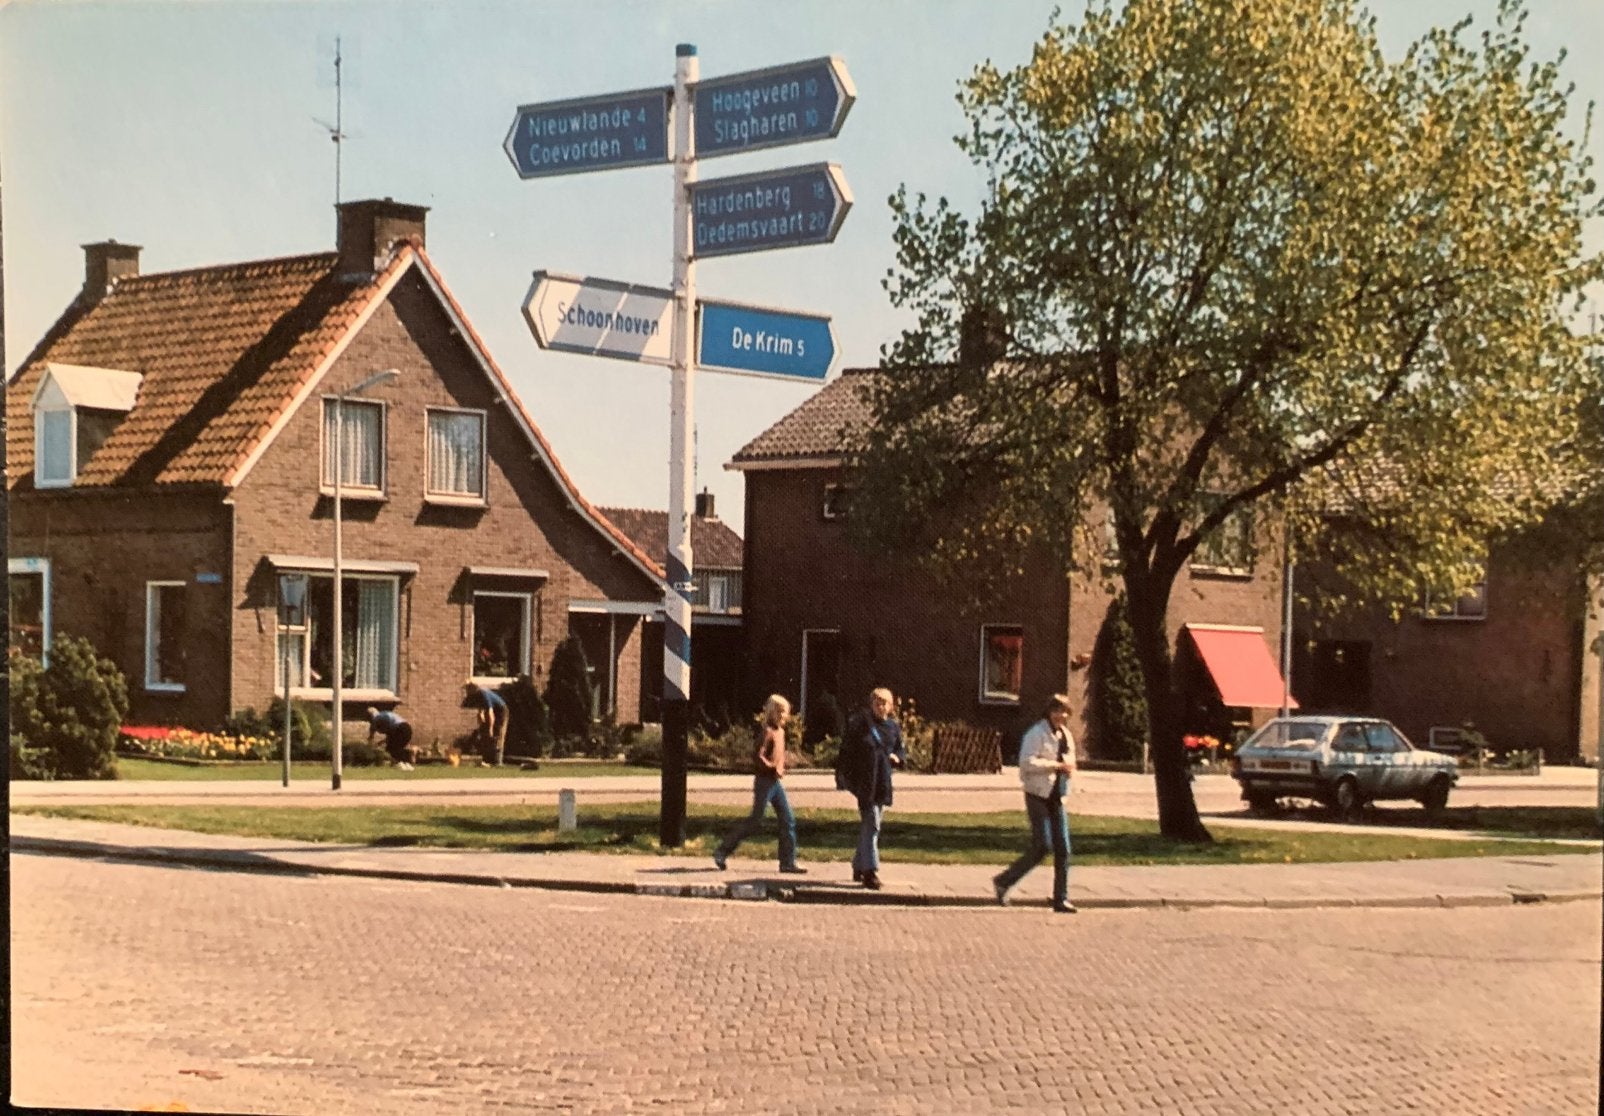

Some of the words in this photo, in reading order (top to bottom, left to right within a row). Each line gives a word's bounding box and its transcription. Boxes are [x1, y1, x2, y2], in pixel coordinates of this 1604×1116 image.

[712, 81, 800, 115] Hoogeveen
[528, 106, 631, 138] Nieuwlande
[637, 106, 646, 124] 4
[714, 112, 798, 144] Slagharen
[529, 136, 621, 167] Coevorden
[697, 185, 791, 215] Hardenberg
[697, 211, 803, 246] Dedemsvaart
[809, 211, 826, 231] 20
[557, 302, 659, 336] Schoonhoven
[732, 327, 752, 350] De
[755, 331, 793, 355] Krim
